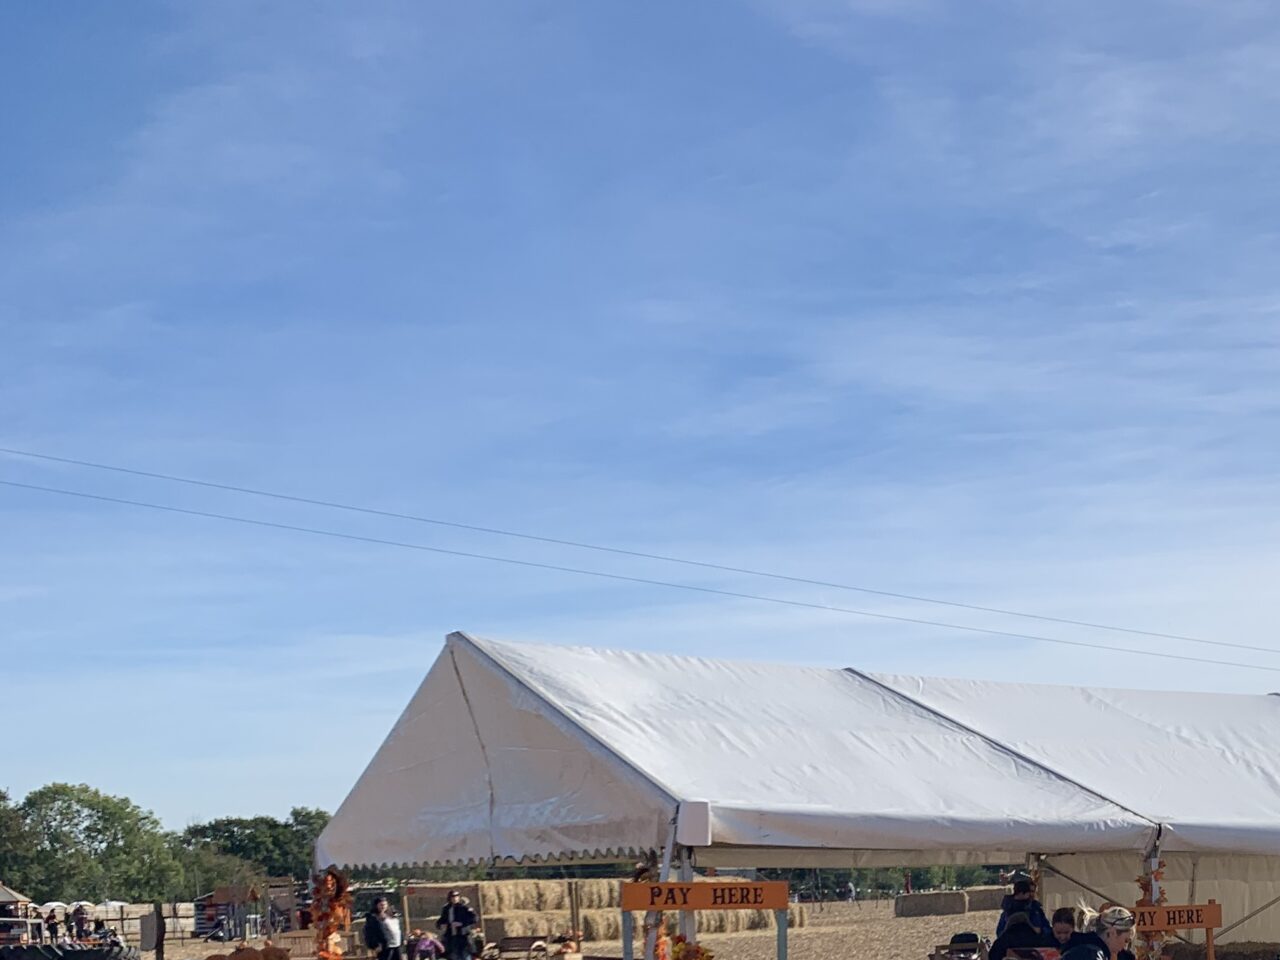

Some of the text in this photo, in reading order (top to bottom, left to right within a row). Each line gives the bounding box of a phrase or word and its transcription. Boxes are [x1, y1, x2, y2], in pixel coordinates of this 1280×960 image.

[649, 885, 764, 906] PAY HERE
[1166, 908, 1204, 926] HERE
